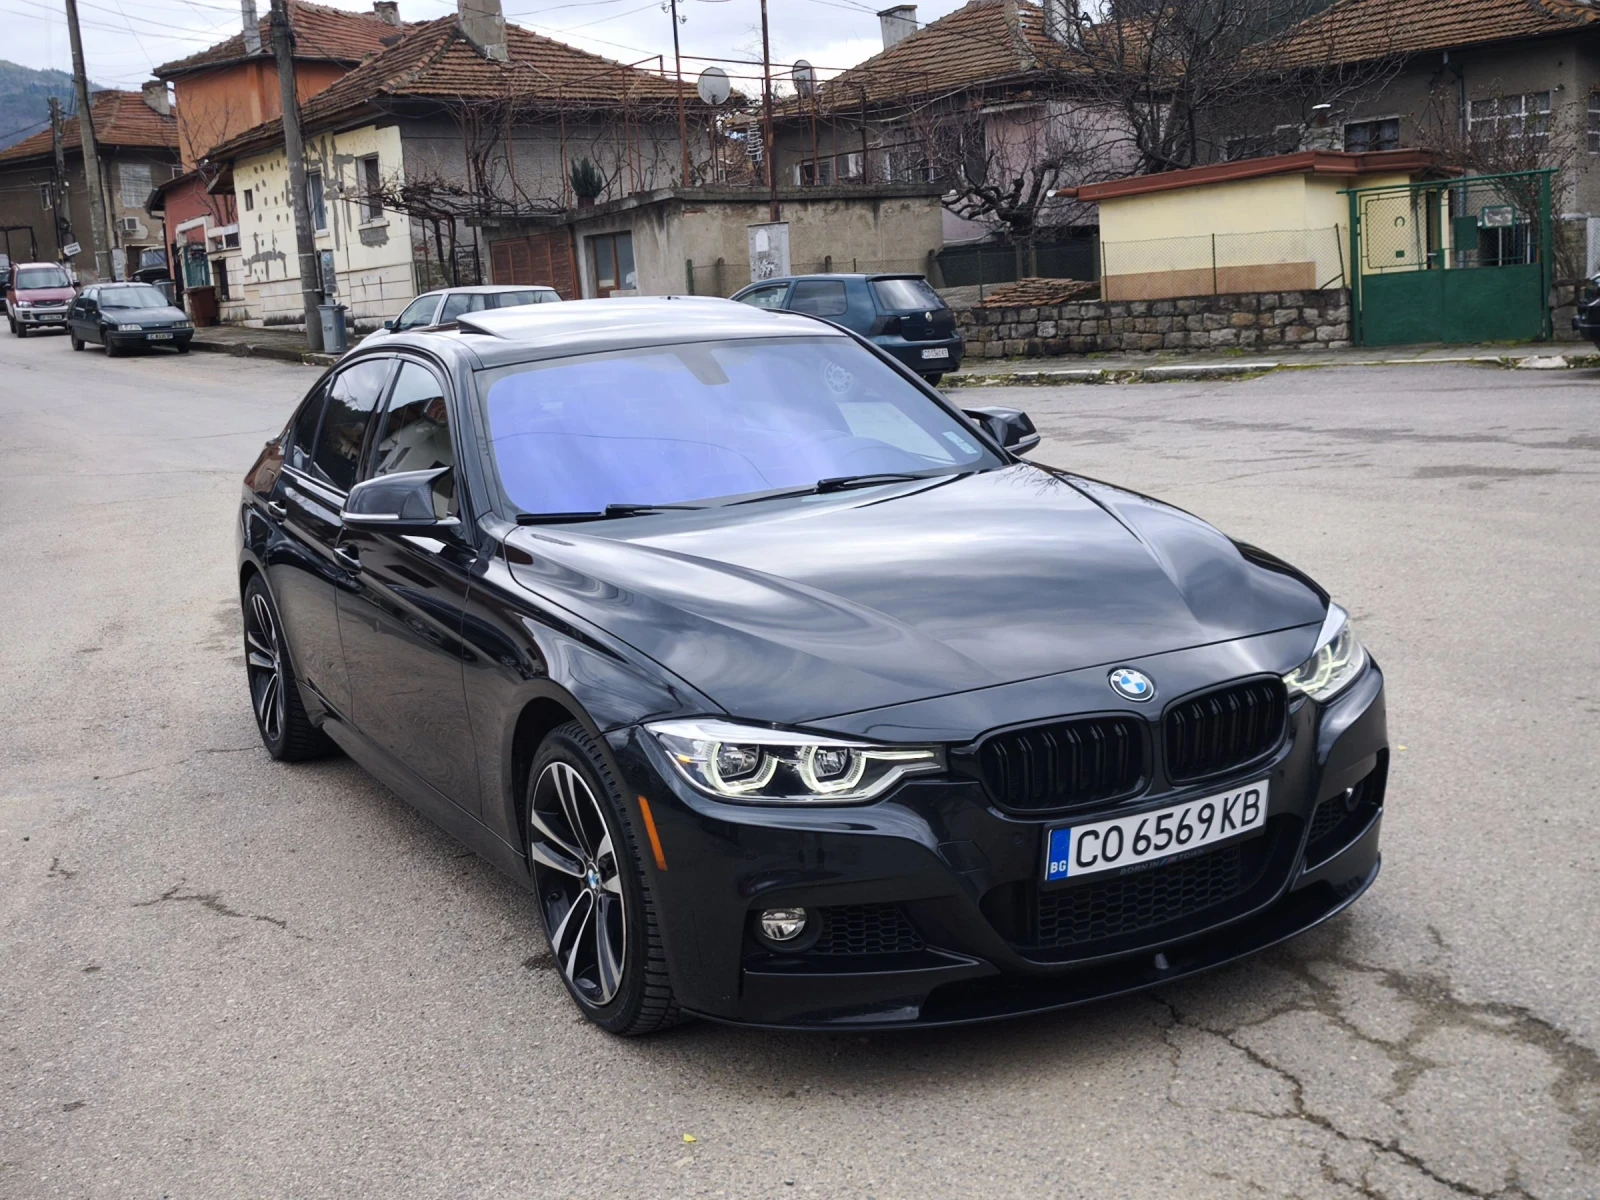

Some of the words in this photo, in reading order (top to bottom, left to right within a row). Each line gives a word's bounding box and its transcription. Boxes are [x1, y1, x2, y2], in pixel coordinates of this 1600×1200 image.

[1075, 825, 1125, 868] CO
[1132, 802, 1215, 856] 6569
[1219, 788, 1261, 834] KB
[1049, 859, 1067, 874] BG
[1119, 864, 1148, 875] BORN
[1149, 861, 1160, 869] IN
[1179, 848, 1205, 860] TOWN
